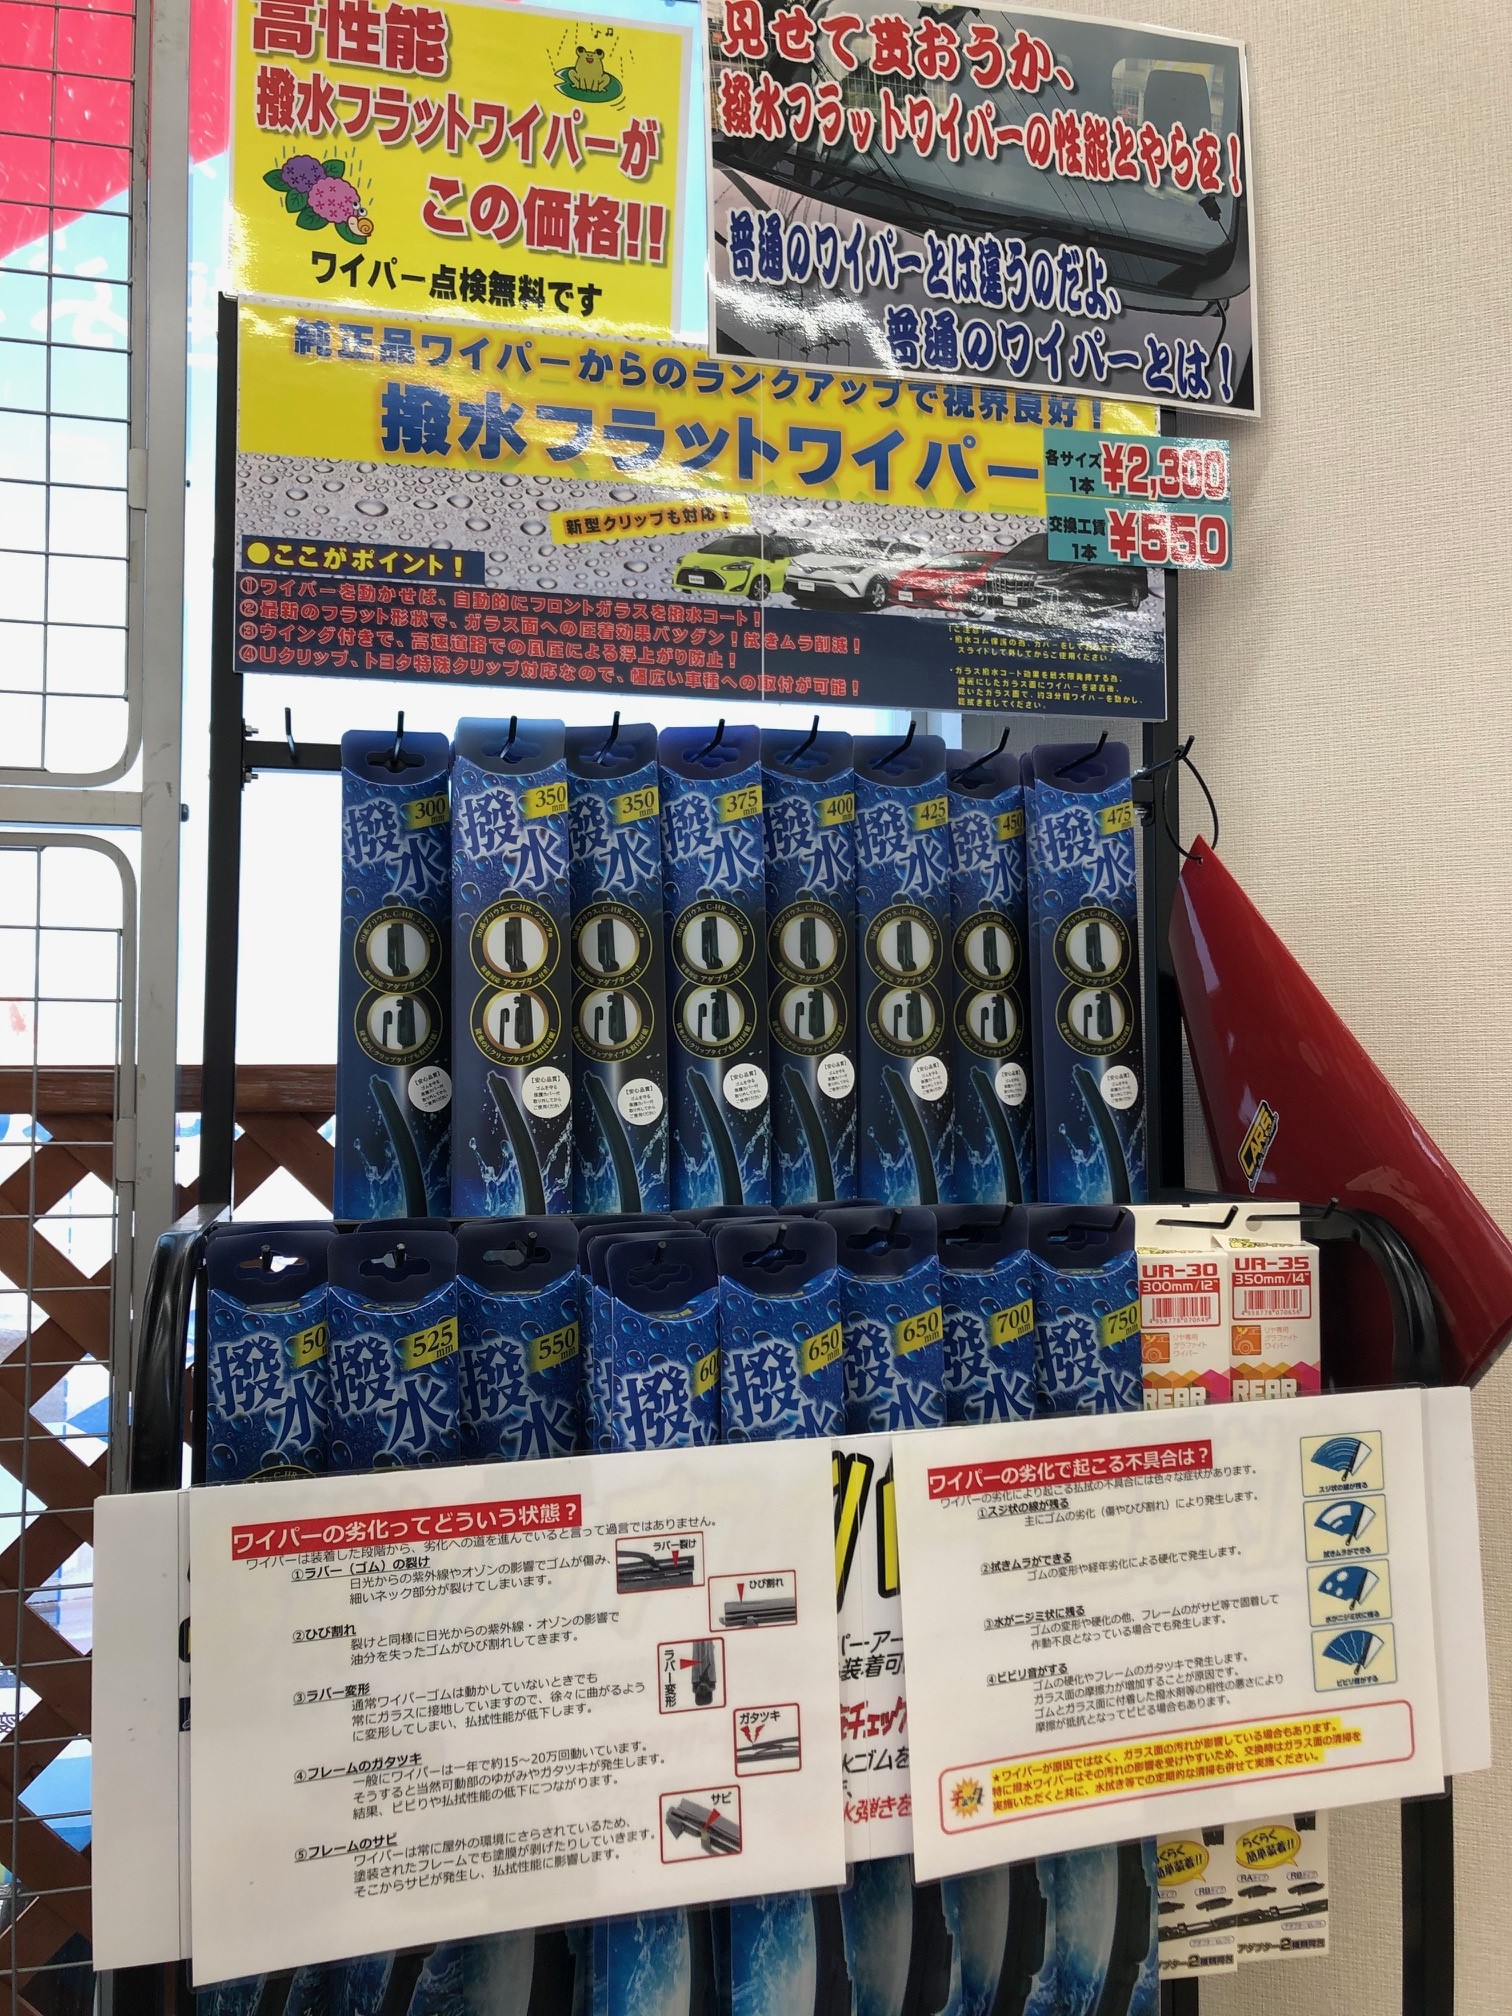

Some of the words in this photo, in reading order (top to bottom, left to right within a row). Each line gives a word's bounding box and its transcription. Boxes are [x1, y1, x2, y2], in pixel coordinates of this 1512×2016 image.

[251, 0, 449, 76] 高性能
[255, 64, 662, 180] 撥水フラットワイパーが
[728, 211, 1122, 321] 普通のワイパーとは違うのだよ、
[311, 250, 602, 317] ワイパー点検無料です
[884, 306, 1234, 402] 普通のワイパーとは！
[380, 382, 1040, 495] 撥水フラットワイパー
[1046, 449, 1101, 468] 各サイズ
[1099, 441, 1227, 501] ¥2,300
[1070, 477, 1095, 494] 1本
[1049, 516, 1106, 536] 交換工賃
[1105, 508, 1228, 566] ¥550
[1072, 544, 1097, 561] 1本
[535, 784, 566, 807] 350
[622, 792, 654, 814] 350
[726, 790, 759, 813] 375
[827, 797, 853, 816] 400
[414, 802, 446, 820] 300
[920, 801, 947, 820] 425
[1107, 805, 1131, 824] 475
[1142, 1263, 1217, 1278] UR-30
[1235, 1257, 1309, 1271] UR-35
[904, 1312, 940, 1342] 650
[998, 1305, 1032, 1335] 700
[1108, 1306, 1139, 1336] 750
[302, 1326, 327, 1355] 50
[413, 1325, 454, 1358] 525
[539, 1327, 577, 1361] 550
[808, 1328, 840, 1361] 650
[700, 1352, 720, 1382] 60
[1143, 1387, 1207, 1410] REAR
[1233, 1378, 1298, 1402] REAR
[929, 1448, 1209, 1494] ワイパーの劣化で起こる不具合は？
[233, 1503, 577, 1554] ワイパーの劣化ってどういう状態？
[653, 1538, 698, 1552] ラバー裂け
[749, 1577, 785, 1589] ひび割れ
[740, 1710, 781, 1725] ガタツキ
[711, 1792, 732, 1805] サビ
